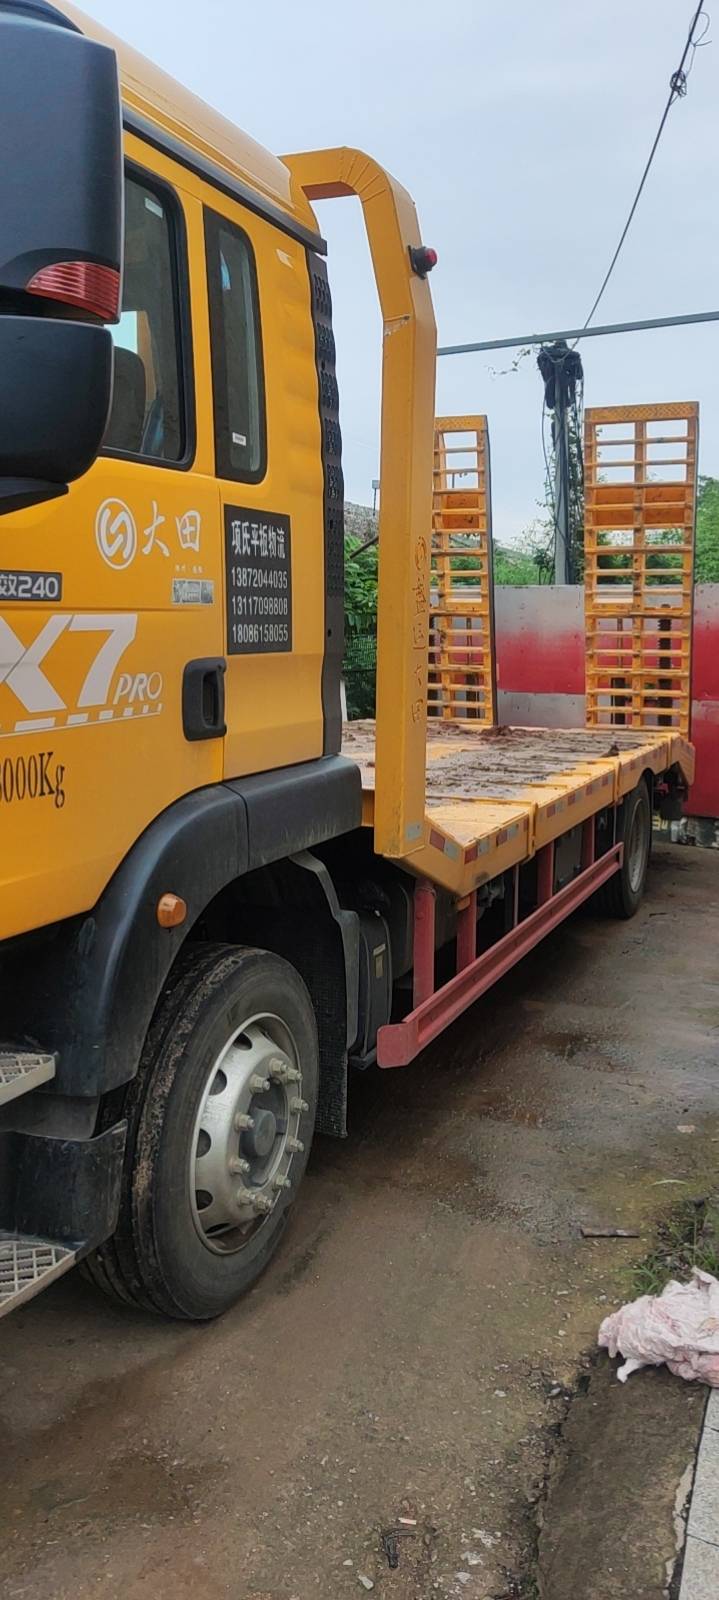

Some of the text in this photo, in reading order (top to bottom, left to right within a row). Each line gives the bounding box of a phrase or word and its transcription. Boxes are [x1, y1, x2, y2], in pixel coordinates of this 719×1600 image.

[142, 500, 201, 557] 大田
[231, 519, 286, 559] 项氏平板物流
[231, 566, 288, 588] 13872044035
[232, 595, 288, 616] 13117098808
[233, 623, 289, 643] 18086158055
[113, 672, 163, 705] PRO
[0, 751, 65, 809] 000Kg
